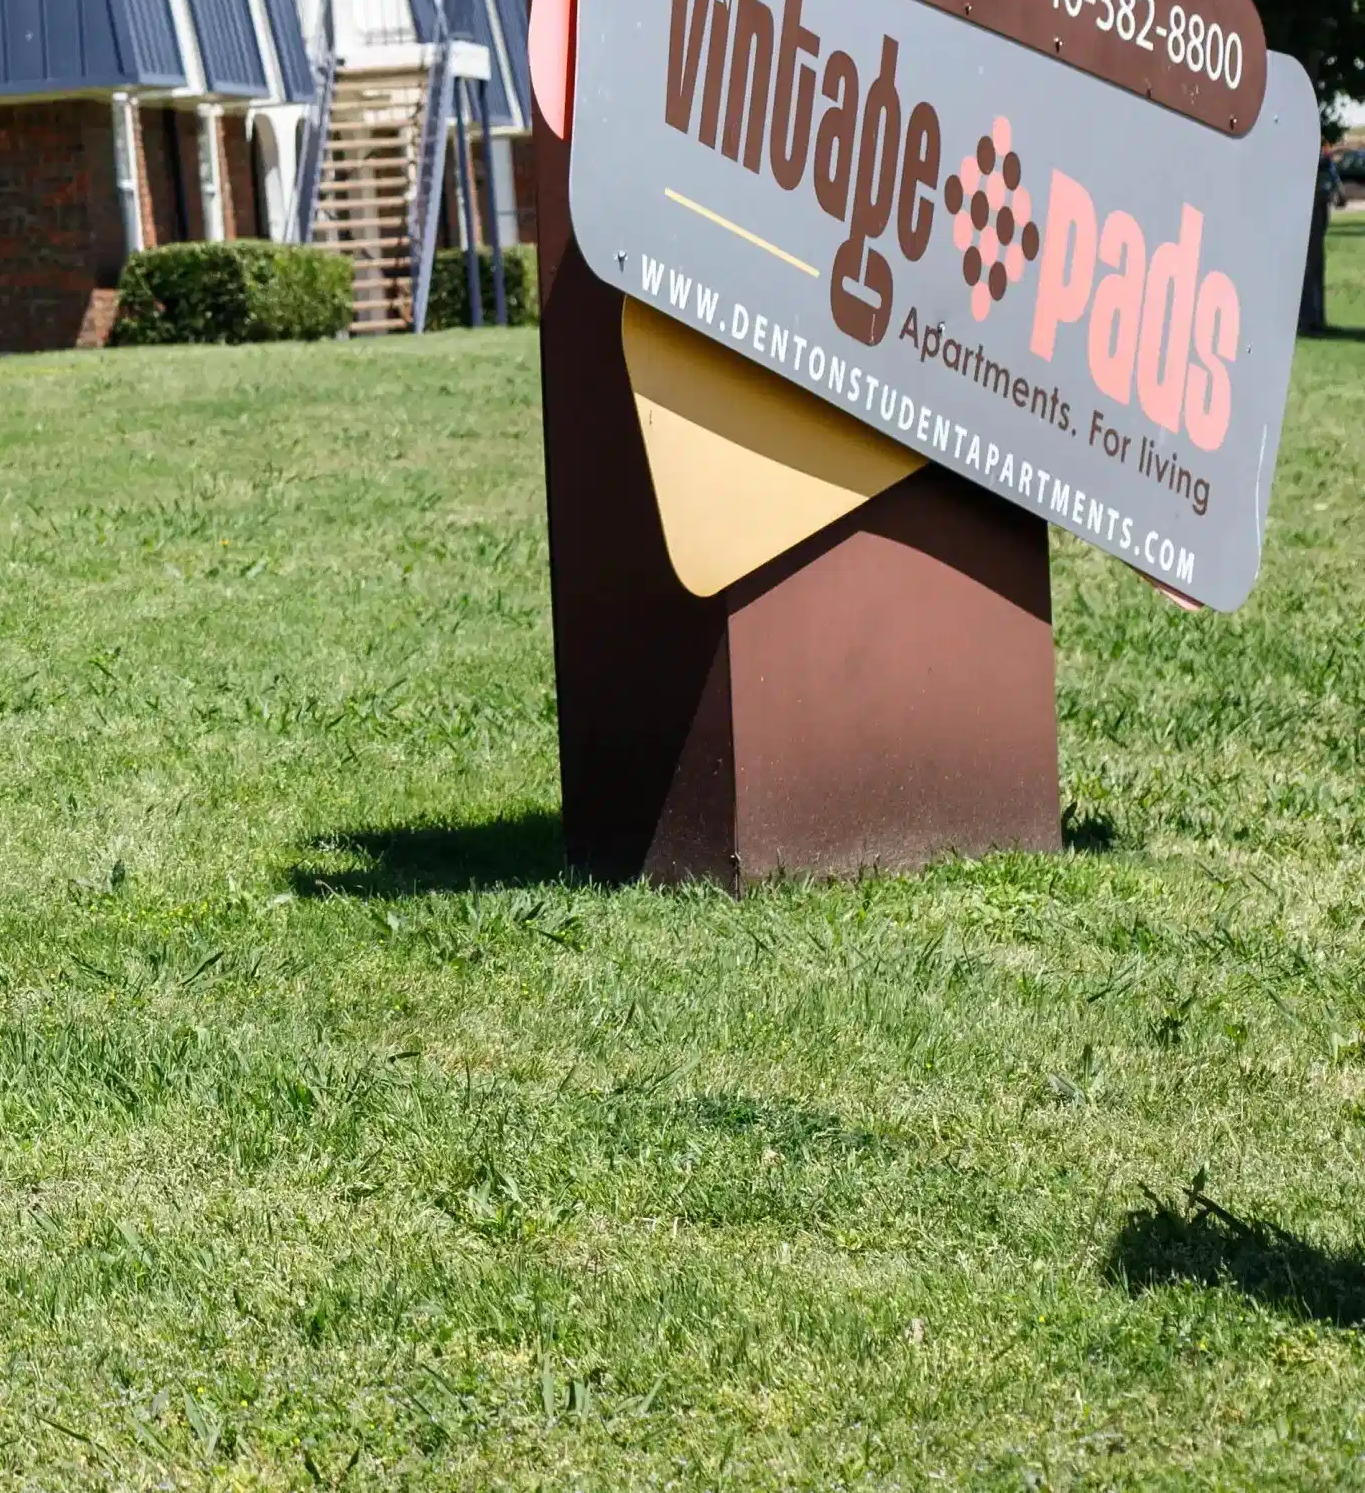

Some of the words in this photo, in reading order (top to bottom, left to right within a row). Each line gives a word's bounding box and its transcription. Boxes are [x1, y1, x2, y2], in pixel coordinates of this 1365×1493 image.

[640, 254, 1196, 584] WWW.DENTONSTUDENTAPARTMENTS.COM
[898, 306, 1077, 437] Apartments.
[1088, 409, 1132, 463] For
[1138, 435, 1210, 516] living
